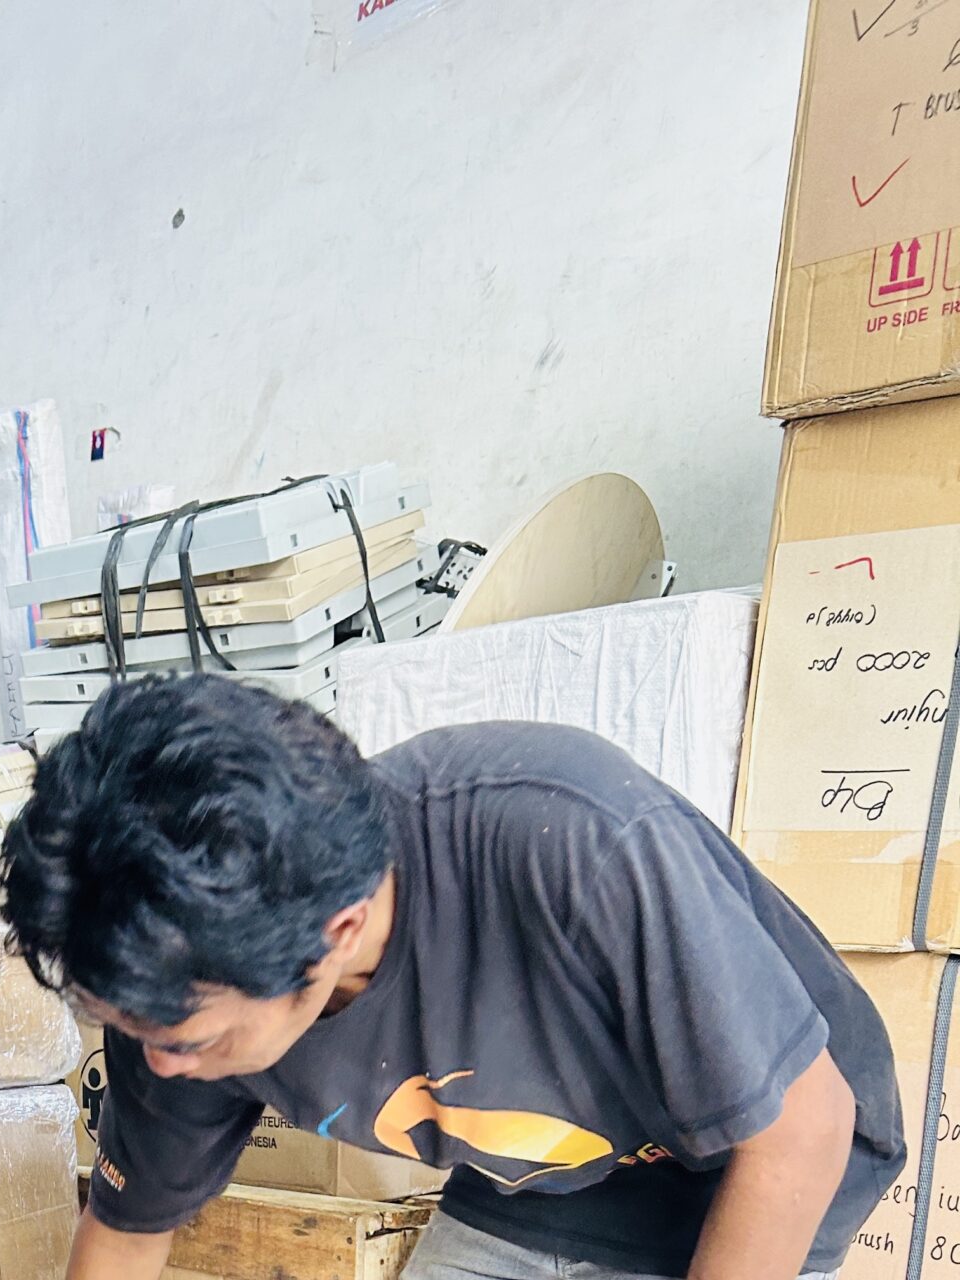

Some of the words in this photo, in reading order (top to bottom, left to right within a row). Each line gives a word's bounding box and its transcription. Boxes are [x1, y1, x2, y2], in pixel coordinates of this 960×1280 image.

[867, 316, 888, 333] UP
[892, 306, 929, 328] SIDE
[856, 650, 931, 673] 2000
